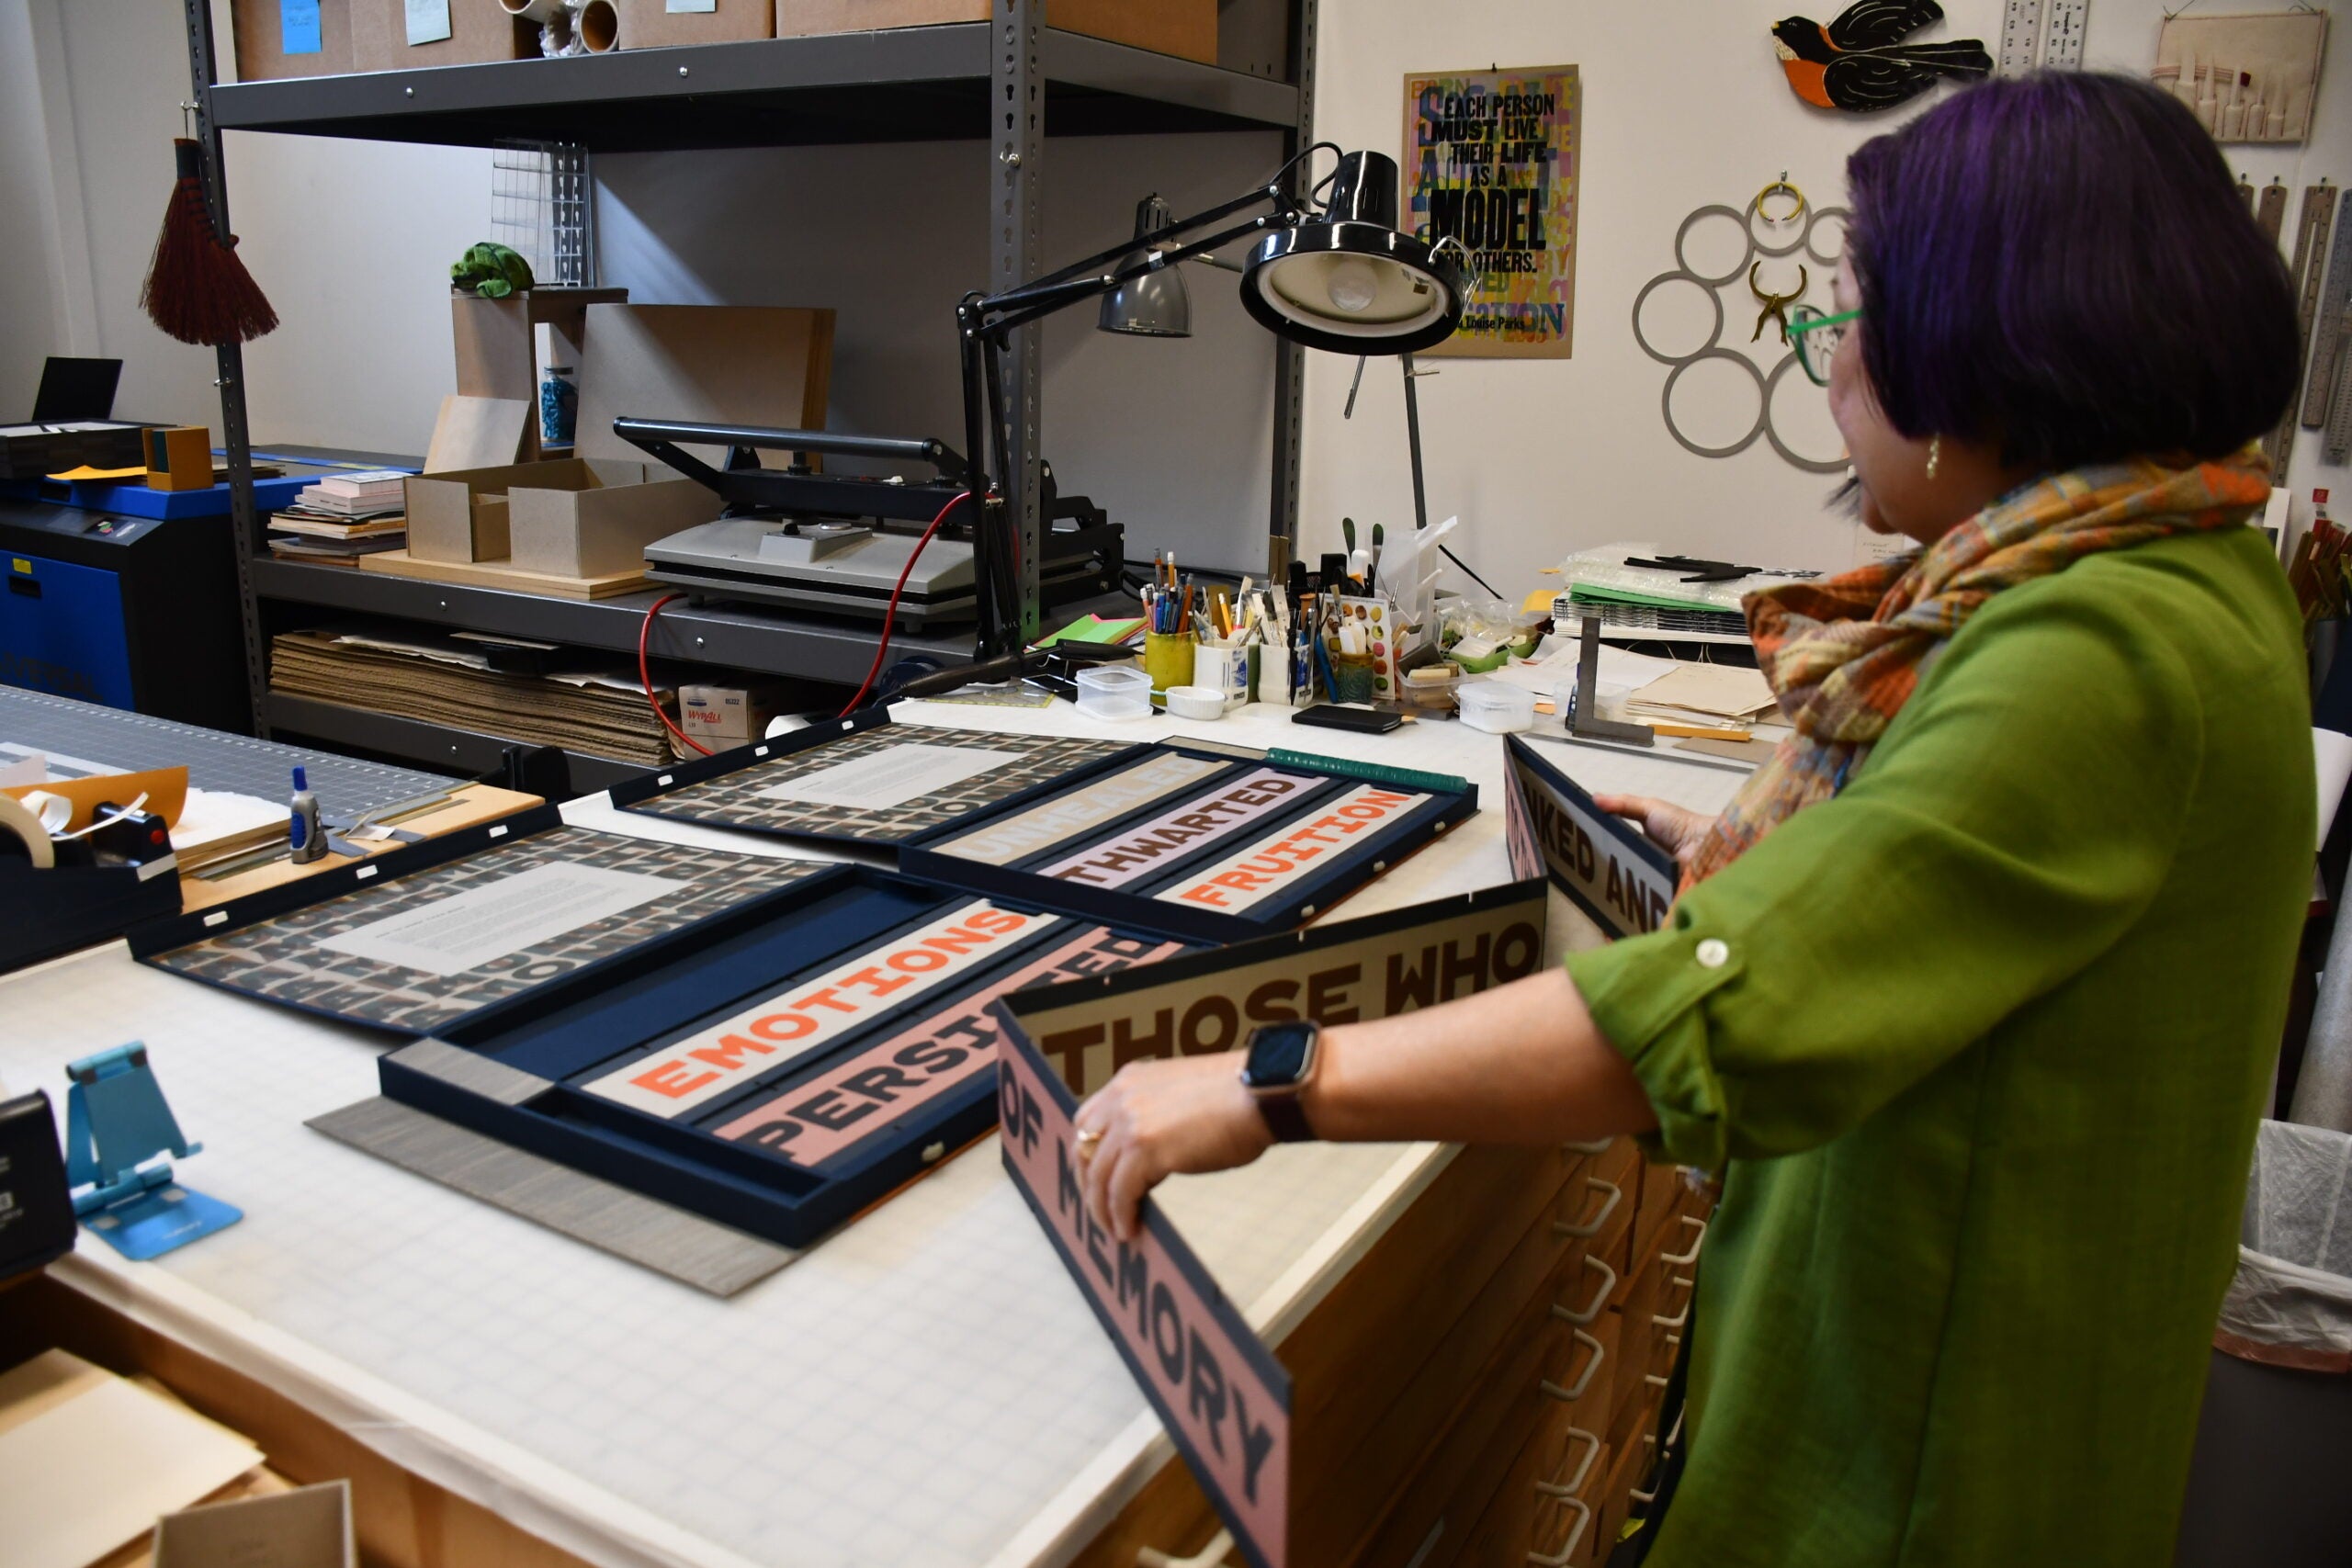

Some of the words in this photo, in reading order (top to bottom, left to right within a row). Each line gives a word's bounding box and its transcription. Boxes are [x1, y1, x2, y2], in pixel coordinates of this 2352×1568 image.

[1430, 119, 1498, 142] MUST
[1505, 118, 1539, 141] LIVE
[1443, 96, 1487, 118] EACH
[1492, 94, 1555, 118] PERSON
[1451, 142, 1495, 165] THEIR
[1499, 141, 1547, 164] LIFE
[1470, 166, 1490, 187] AS
[1498, 166, 1508, 187] A
[1429, 188, 1547, 251] MODEL
[1472, 250, 1538, 273] OTHERS.
[1466, 315, 1496, 330] Louise
[1498, 317, 1526, 330] Parks
[953, 756, 1208, 863] UNHEALED
[1053, 777, 1297, 889] THWARTED
[1180, 789, 1412, 908] FRUITION
[629, 908, 1028, 1100] EMOTIONS
[1041, 963, 1362, 1098] THOSE
[1385, 921, 1540, 1018] WHO
[738, 934, 1156, 1157] PERSIED
[1000, 1059, 1044, 1161] OF
